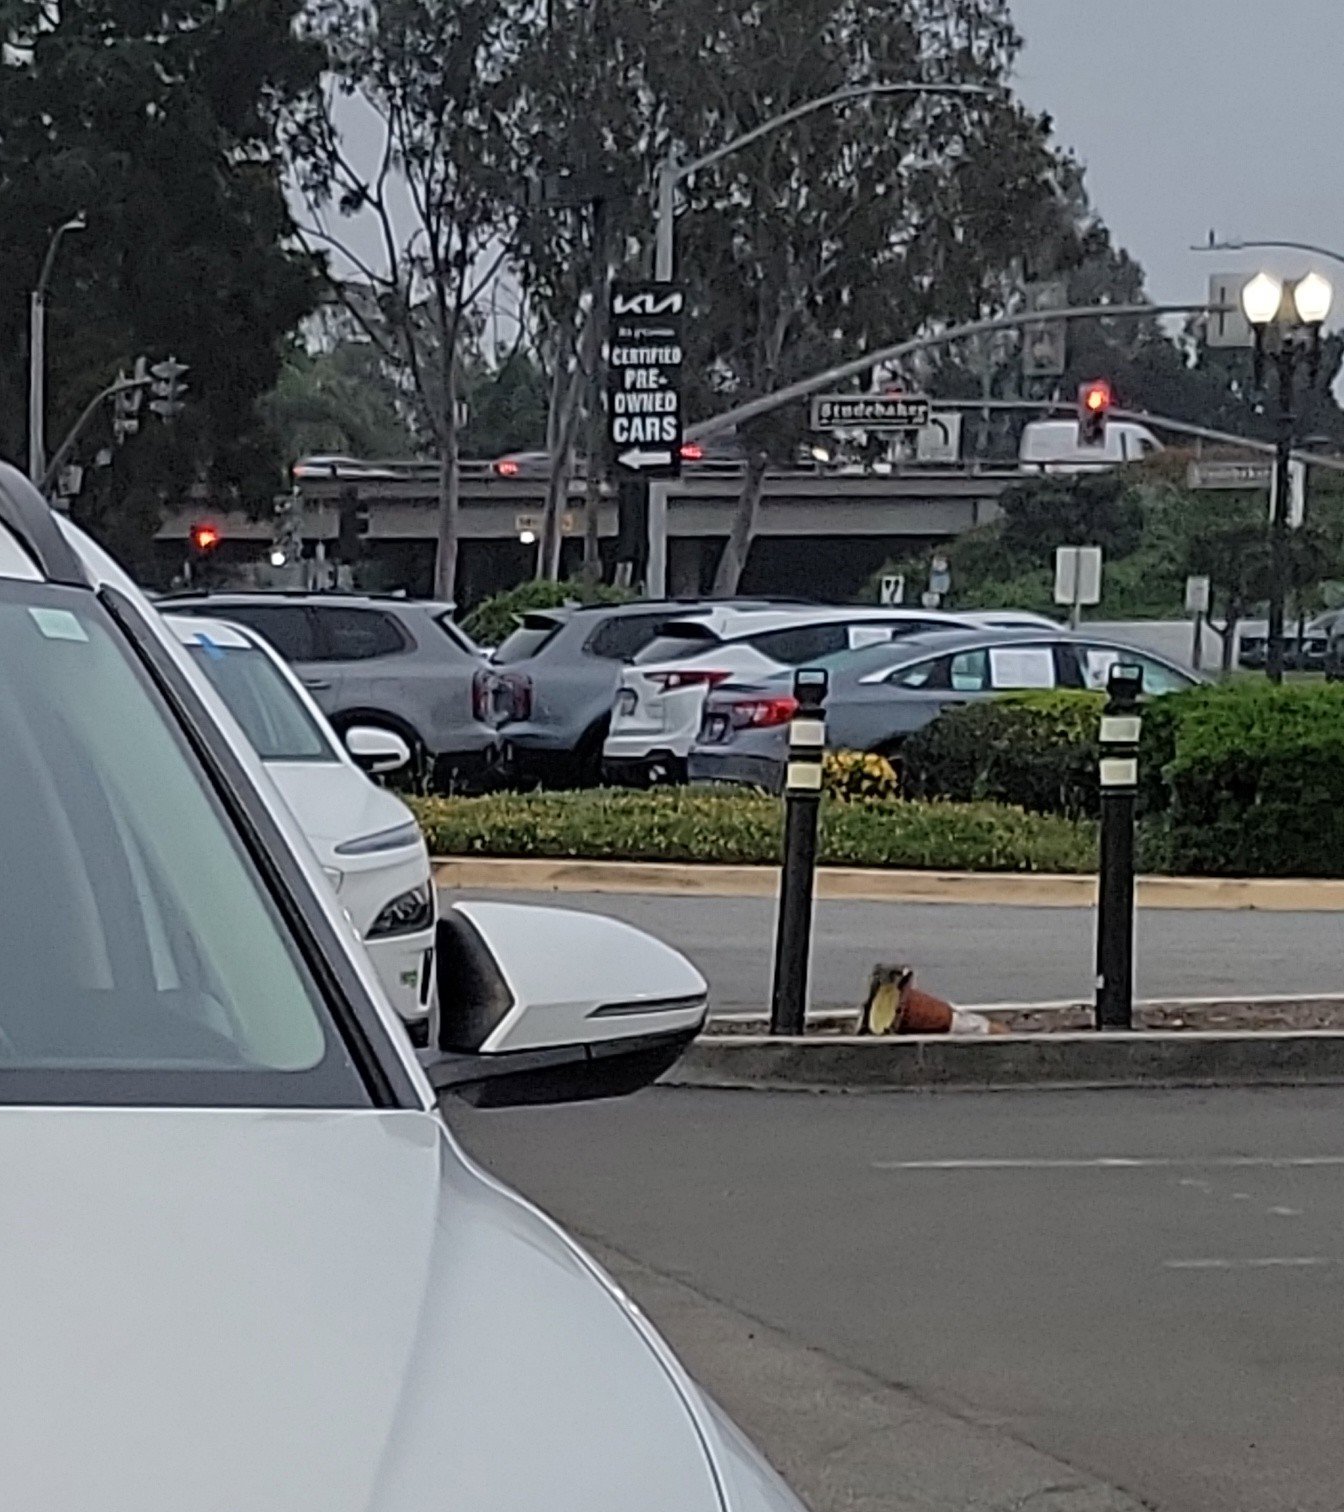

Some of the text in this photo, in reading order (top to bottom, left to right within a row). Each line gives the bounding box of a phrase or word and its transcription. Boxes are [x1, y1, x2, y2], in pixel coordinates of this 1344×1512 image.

[612, 345, 682, 366] CERTIFIED
[624, 367, 668, 390] PRE-
[614, 390, 677, 414] OWNED
[820, 401, 927, 419] Studebaker
[613, 416, 678, 443] CARS
